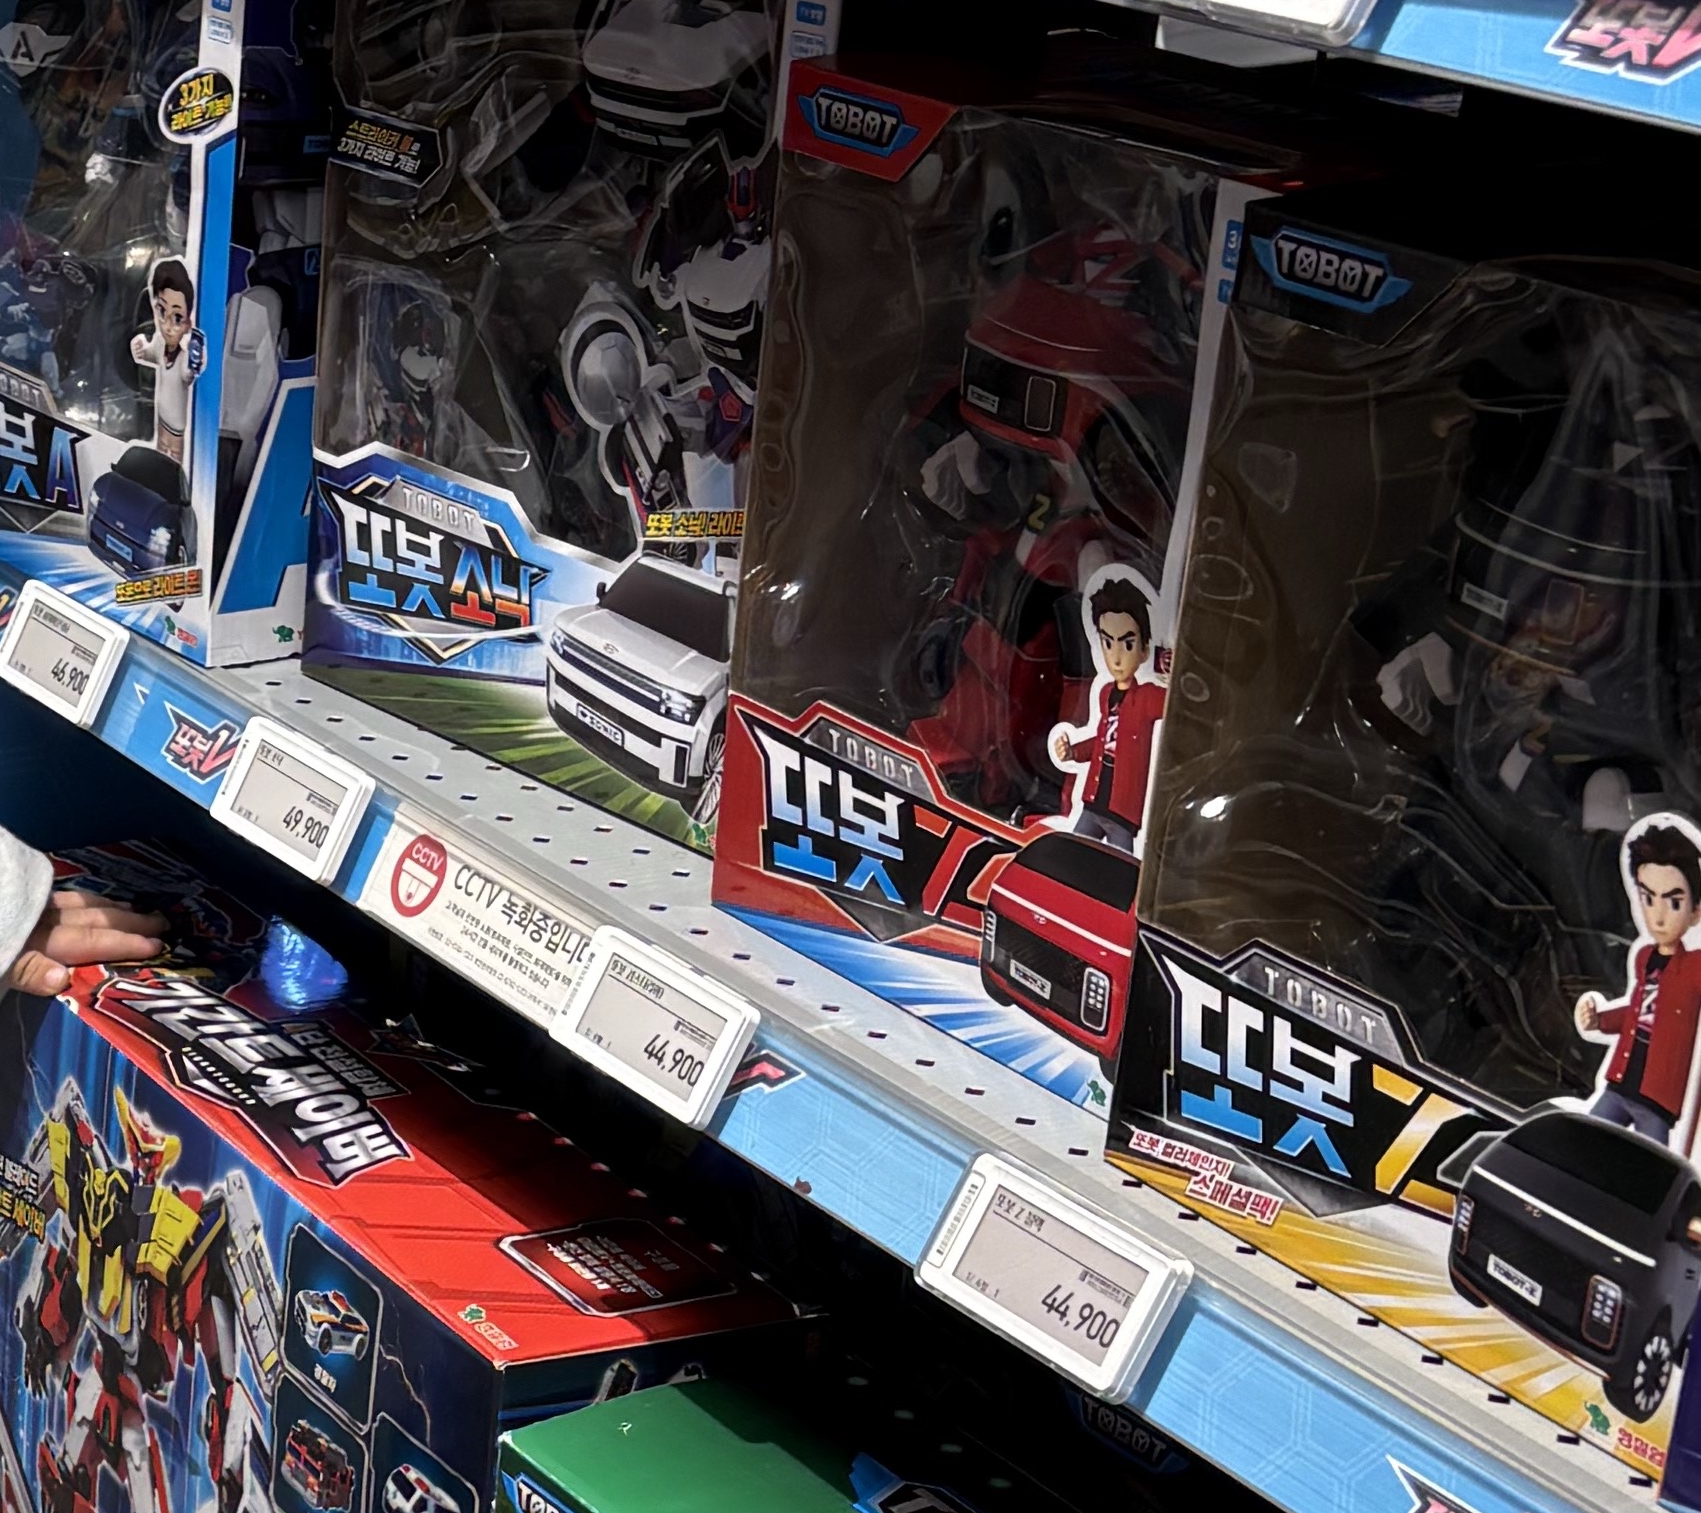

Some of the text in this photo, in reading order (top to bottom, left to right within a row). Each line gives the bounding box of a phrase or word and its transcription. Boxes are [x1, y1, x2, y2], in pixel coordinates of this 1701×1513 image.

[179, 73, 214, 107] 3가지
[817, 95, 898, 144] TOBOT
[1273, 227, 1385, 303] TOBOT
[401, 486, 476, 531] TOBOT
[646, 512, 673, 537] 또봇
[49, 658, 90, 696] 46,900
[828, 728, 915, 788] TOBOT
[282, 808, 331, 849] 49,900
[410, 839, 444, 871] CCTV
[454, 863, 502, 910] CCTV
[1264, 966, 1377, 1044] TOBOT
[643, 1033, 706, 1088] 44,900
[1133, 1131, 1161, 1157] 또봇
[996, 1192, 1015, 1215] 또봇
[1040, 1283, 1122, 1350] 44,900
